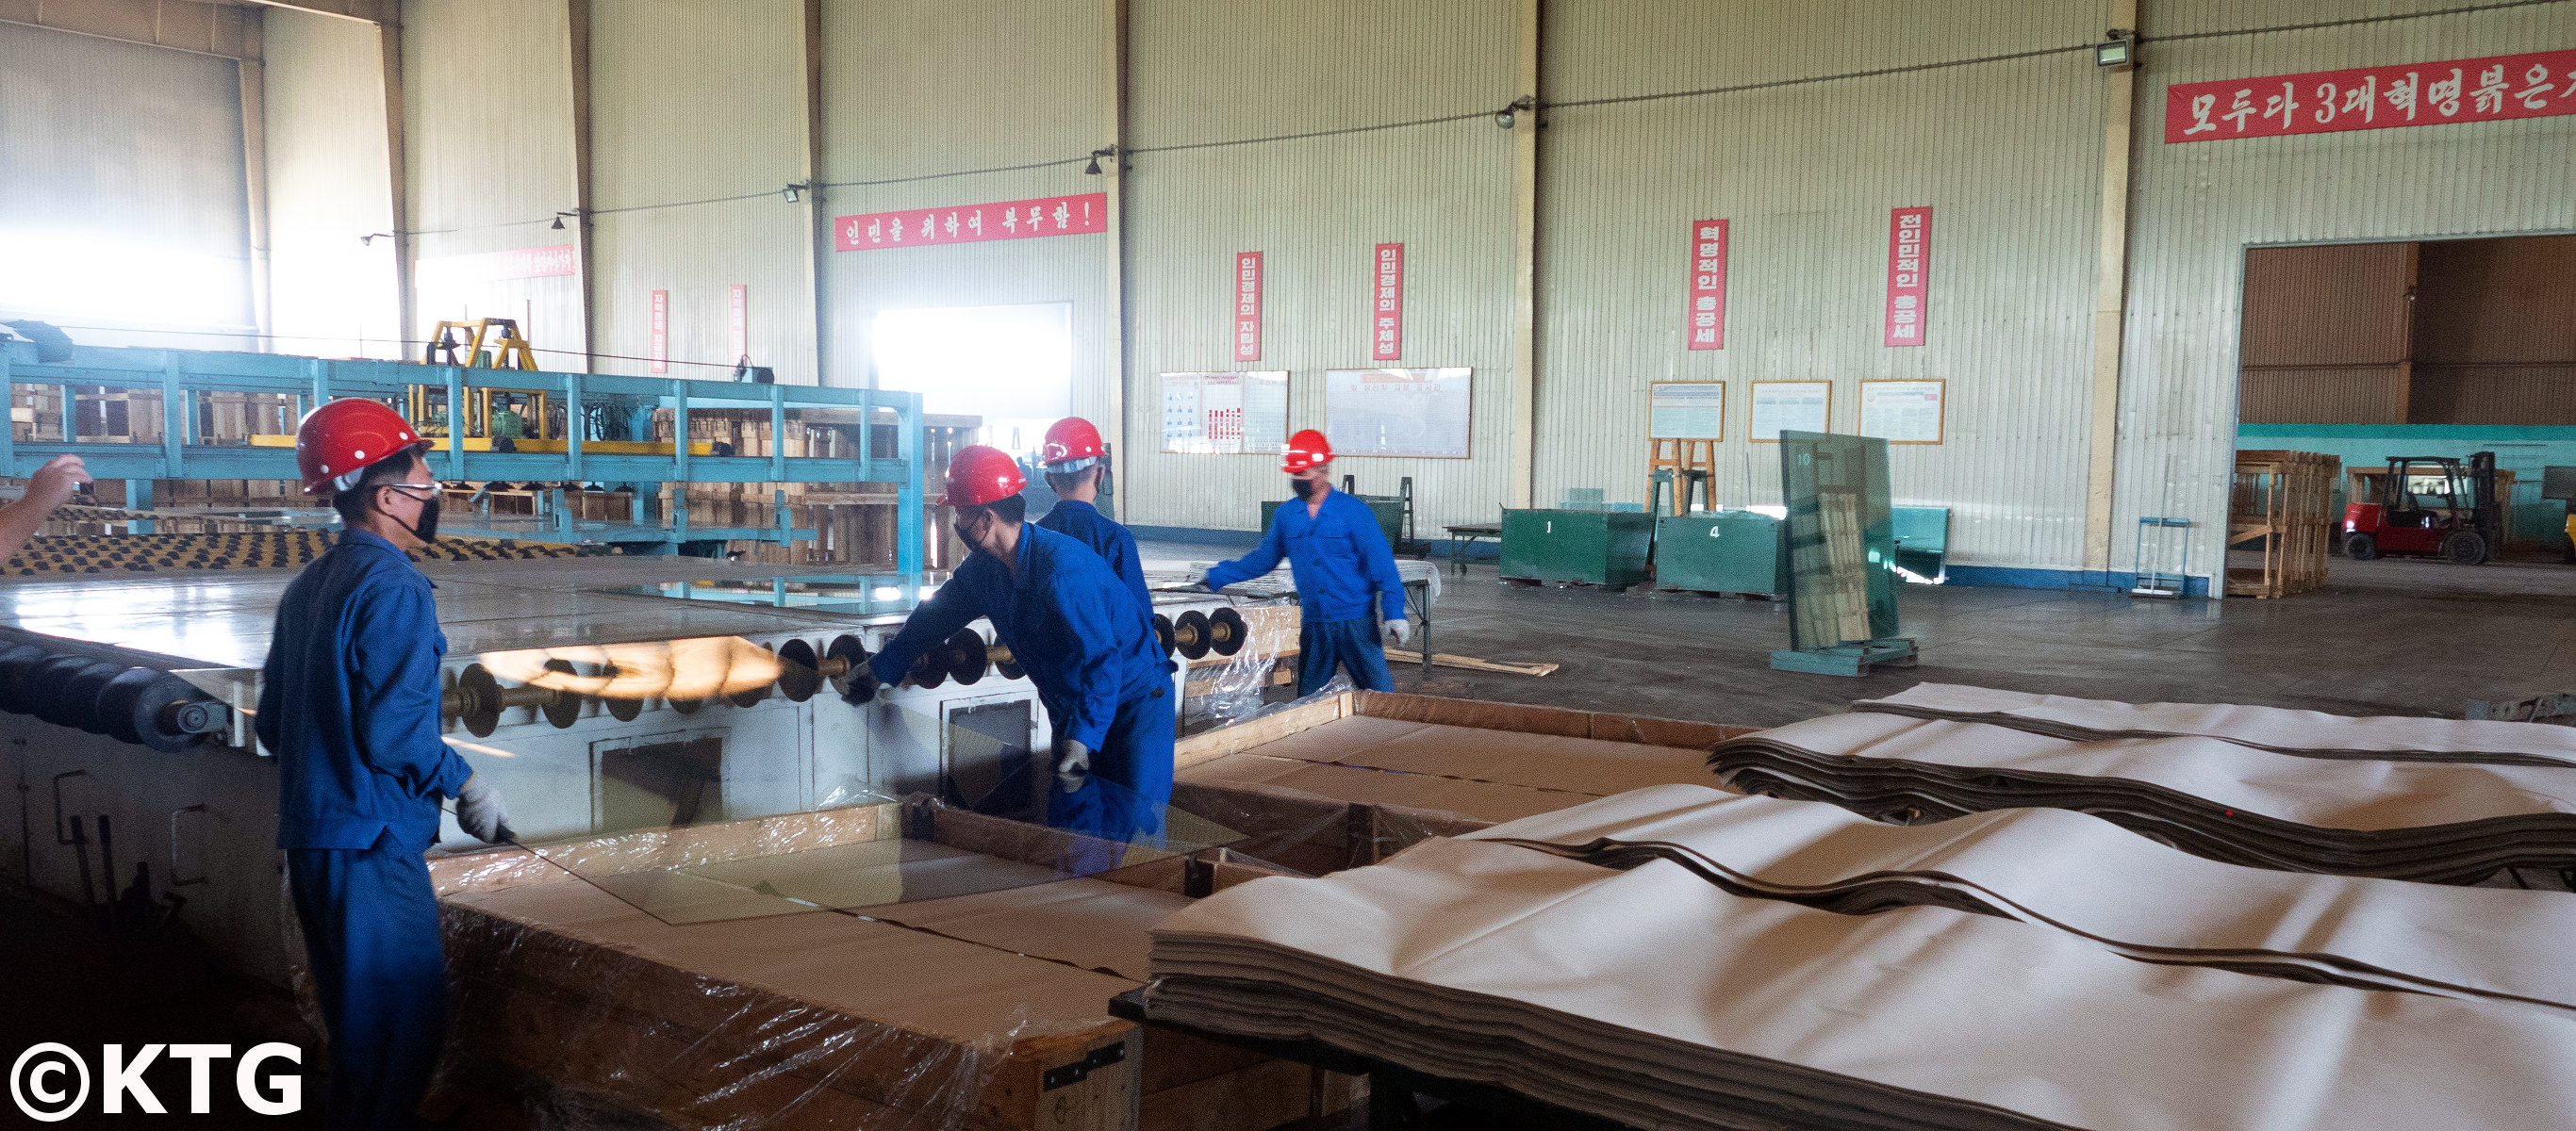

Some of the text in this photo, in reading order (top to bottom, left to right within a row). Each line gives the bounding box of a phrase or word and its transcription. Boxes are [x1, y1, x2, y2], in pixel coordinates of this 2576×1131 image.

[2184, 81, 2300, 135] 모두다
[847, 217, 903, 245] 인민을
[920, 209, 982, 240] 위하여
[1240, 257, 1256, 355] 인민경제의 자립성
[1379, 249, 1396, 354] 인민경제의 주체성
[1695, 226, 1719, 342] 혁명적인 총공세
[1893, 214, 1922, 338] 전인민적인 총공세
[1546, 520, 1552, 533] 1
[1709, 526, 1720, 538] 4
